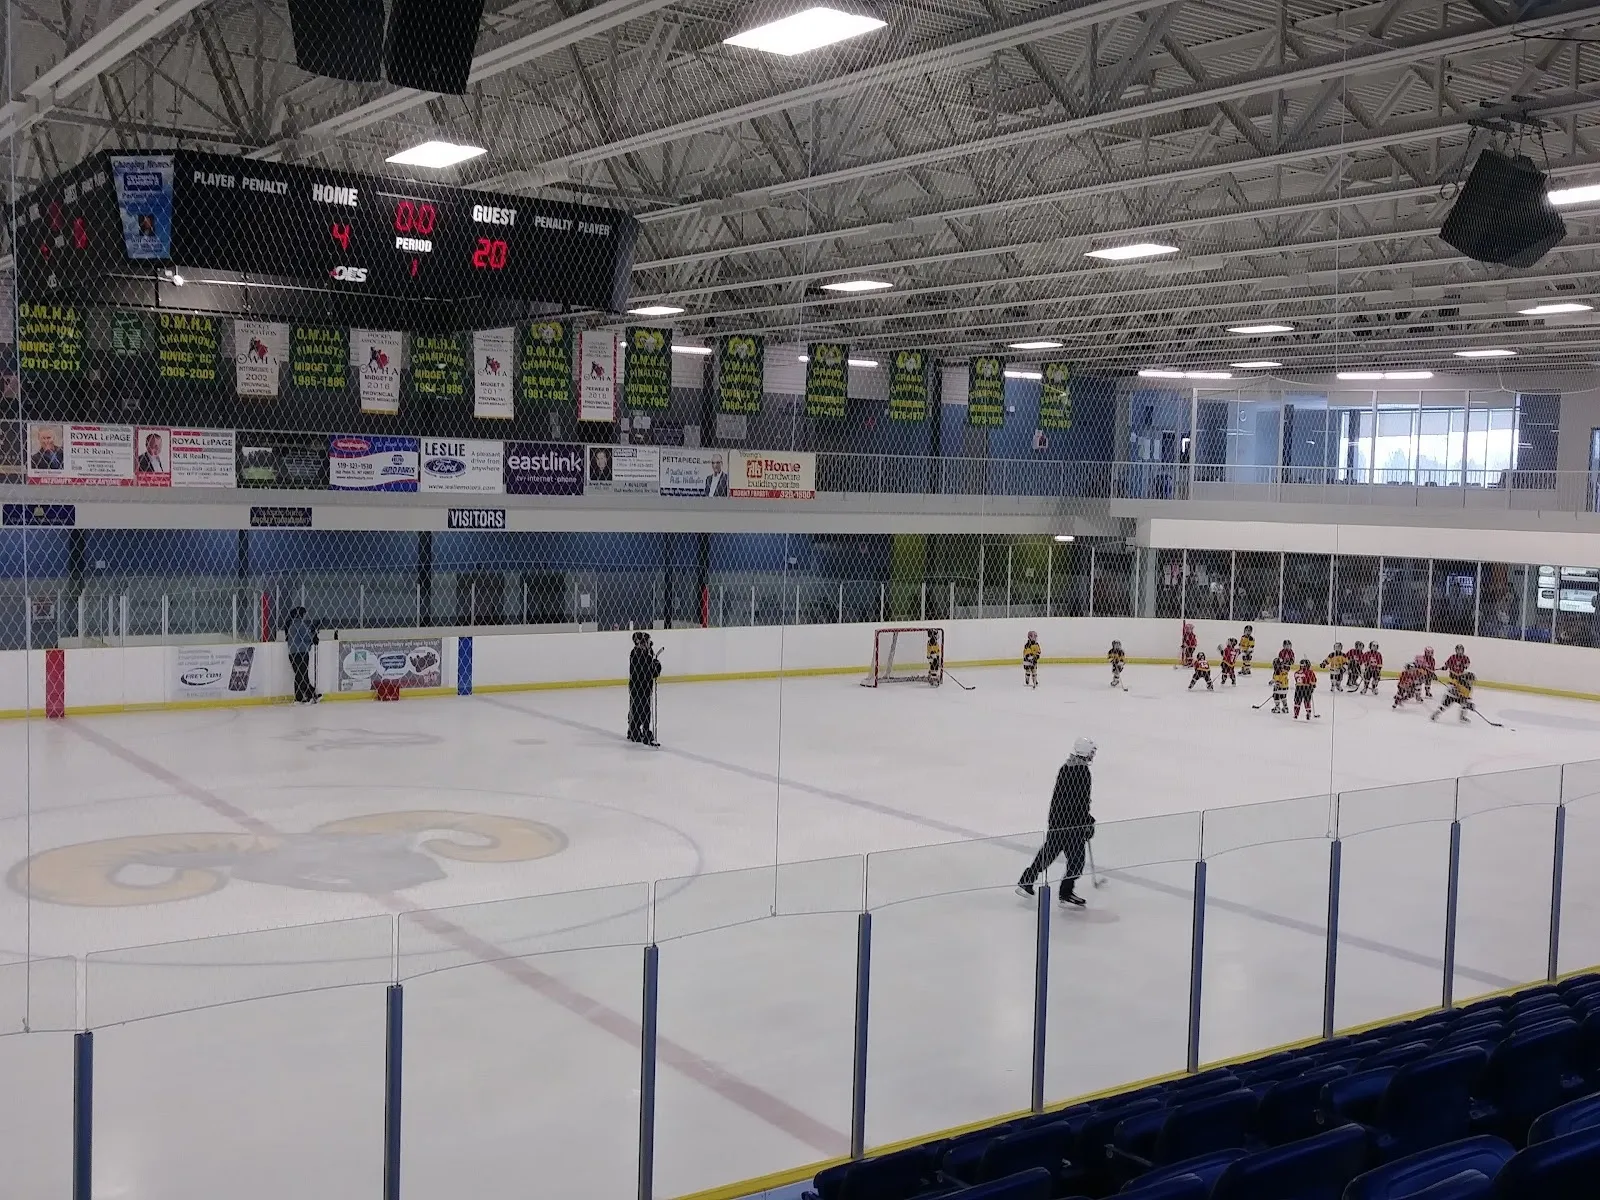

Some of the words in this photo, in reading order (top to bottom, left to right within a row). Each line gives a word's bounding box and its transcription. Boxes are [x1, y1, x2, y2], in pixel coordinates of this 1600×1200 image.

[194, 170, 235, 188] PLAYER
[242, 177, 288, 195] PENALTY
[313, 184, 358, 206] HOME
[473, 204, 517, 226] GUEST
[535, 215, 572, 231] PENALTY
[578, 221, 611, 236] PLAYER
[331, 222, 351, 250] 4
[396, 237, 432, 253] PERIOD
[472, 237, 508, 269] 20
[410, 257, 418, 277] 1
[19, 324, 81, 340] CHAMPIONS
[159, 334, 217, 350] CHAMPIONS
[412, 351, 465, 366] CHAMPIONS
[70, 432, 98, 440] ROYAL
[172, 437, 201, 446] ROYAL
[424, 442, 466, 457] LESLIE
[432, 460, 458, 474] Ford
[507, 451, 582, 472] eastlink
[764, 460, 801, 472] Home
[527, 475, 554, 483] internet
[748, 480, 777, 489] building
[764, 472, 800, 481] hardware
[450, 510, 504, 527] VISITORS
